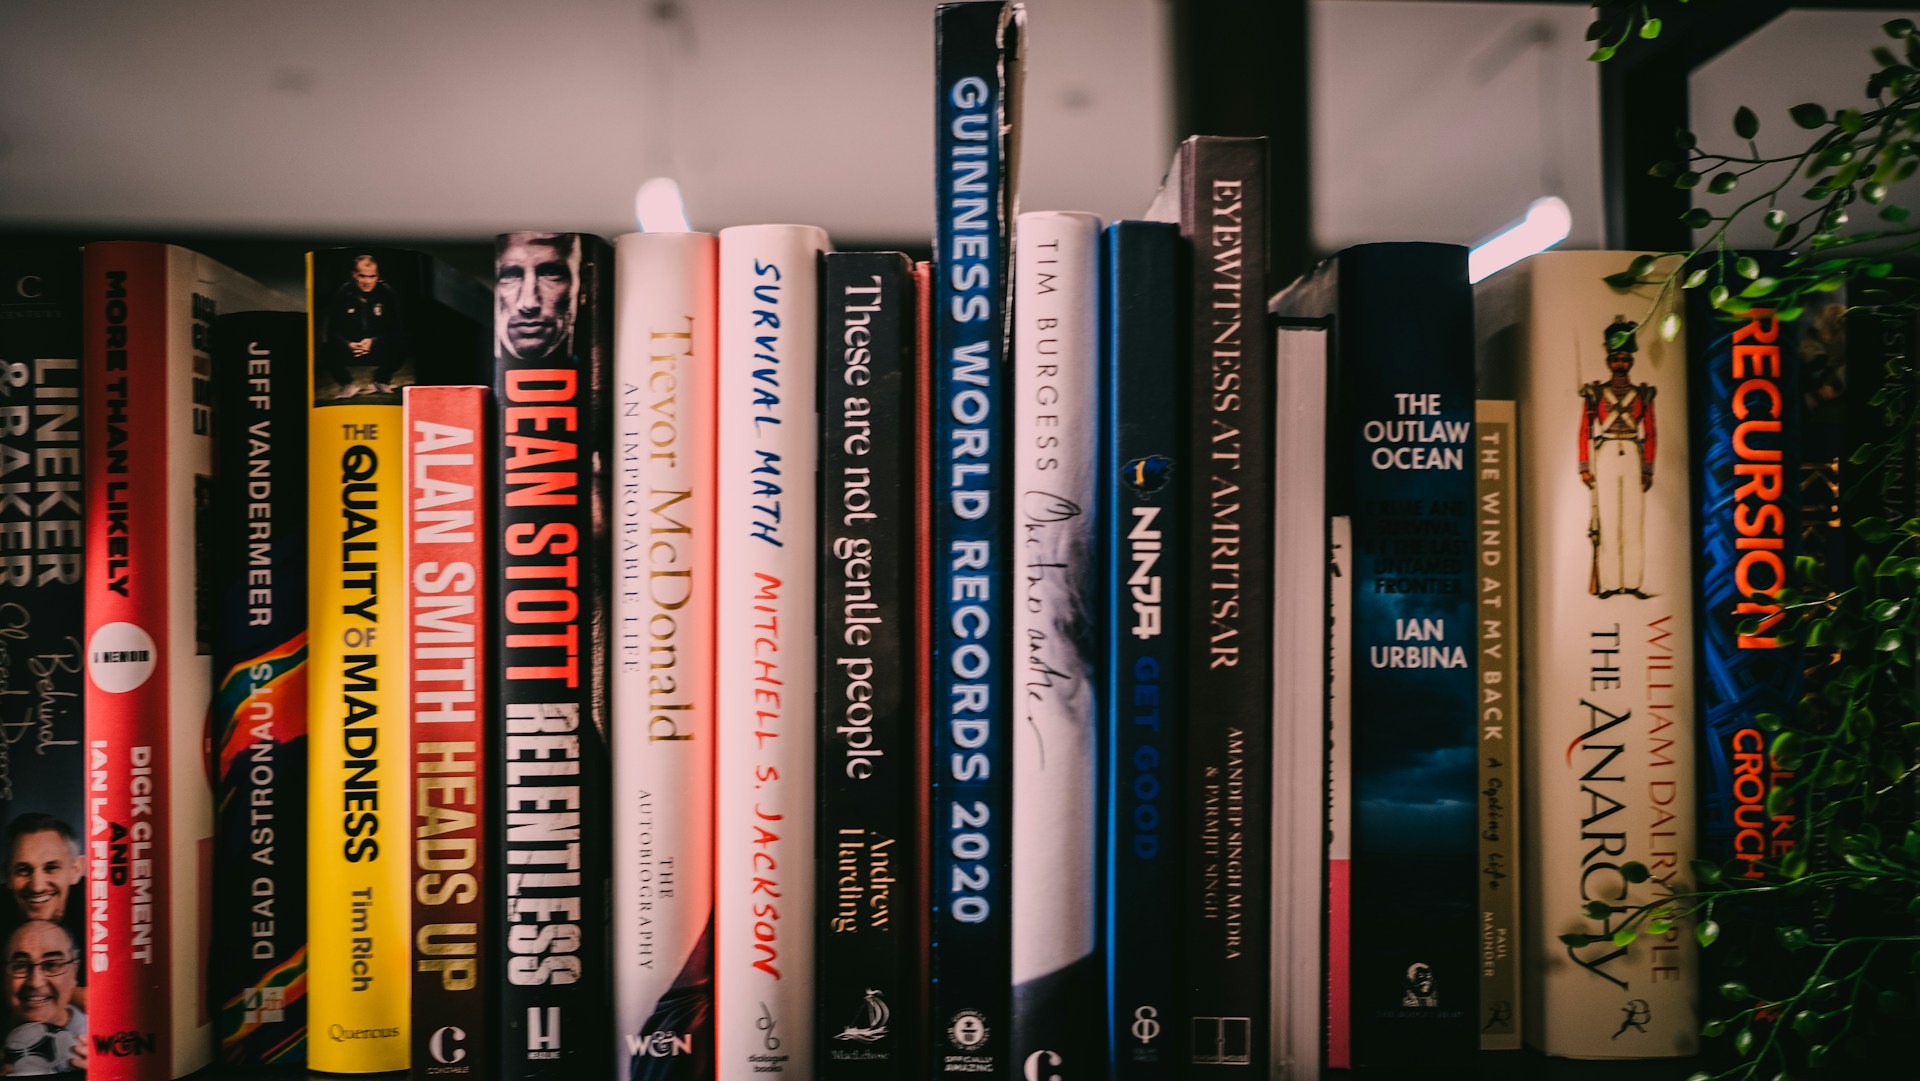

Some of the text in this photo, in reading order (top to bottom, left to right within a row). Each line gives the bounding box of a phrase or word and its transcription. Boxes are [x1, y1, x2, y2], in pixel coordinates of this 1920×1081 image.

[104, 270, 129, 598] MORE THAN LIKELY
[750, 257, 784, 548] SURVIVAL MATH
[1036, 239, 1059, 472] TIM BURGESS
[1209, 179, 1243, 670] EYEWITNESS AT AMRITSAR
[1363, 420, 1470, 444] OUTLAW
[1394, 393, 1441, 416] THE
[0, 405, 32, 588] BAKER
[35, 358, 81, 588] LINEKER
[248, 340, 272, 628] JEFF VANDERMEER
[622, 383, 641, 673] AN IMPROBABLE LIFE
[648, 315, 695, 742] Trevor McDonald
[833, 274, 884, 780] These are not gentle people
[950, 76, 991, 924] GUINNESS WORLD RECORDS 2020
[1371, 447, 1464, 471] OCEAN
[1732, 307, 1786, 649] RECURSION
[341, 424, 379, 863] THE QUALITY OF MADNESS
[1370, 645, 1469, 669] URBINA
[1396, 618, 1444, 642] IAN
[1481, 431, 1503, 741] THE WIND AT MY BACK
[1591, 622, 1621, 692] THE
[26, 636, 83, 755] Behind
[91, 740, 108, 792] IAN
[414, 420, 478, 991] ALAN SMITH HEADS UP
[505, 369, 582, 986] DEAN STOTT RELENTLESS
[1127, 506, 1162, 860] NINJA GET GOOD
[1647, 615, 1676, 767] WILLIAM
[110, 821, 129, 886] AND
[130, 746, 153, 965] DICK CLEMENT
[250, 663, 275, 960] DEAD ASTRONAUTS
[752, 572, 785, 981] MITCHELL S. JACKSON
[1202, 766, 1220, 919] & PARMJIT SINGH
[1225, 727, 1244, 960] AMANDEEP SINGH MADRA
[1482, 757, 1506, 891] A Cycling Life
[1732, 728, 1766, 879] CROUCH
[91, 840, 110, 973] FRENAIS
[351, 887, 375, 992] Tim Rich
[639, 789, 654, 970] AUTOBIOGRAPHY
[659, 856, 675, 900] THE
[831, 828, 865, 933] Harding
[869, 830, 896, 932] Andrew
[1482, 911, 1496, 977] MAUNDER
[1496, 928, 1507, 960] PAUL
[429, 1026, 466, 1064] C
